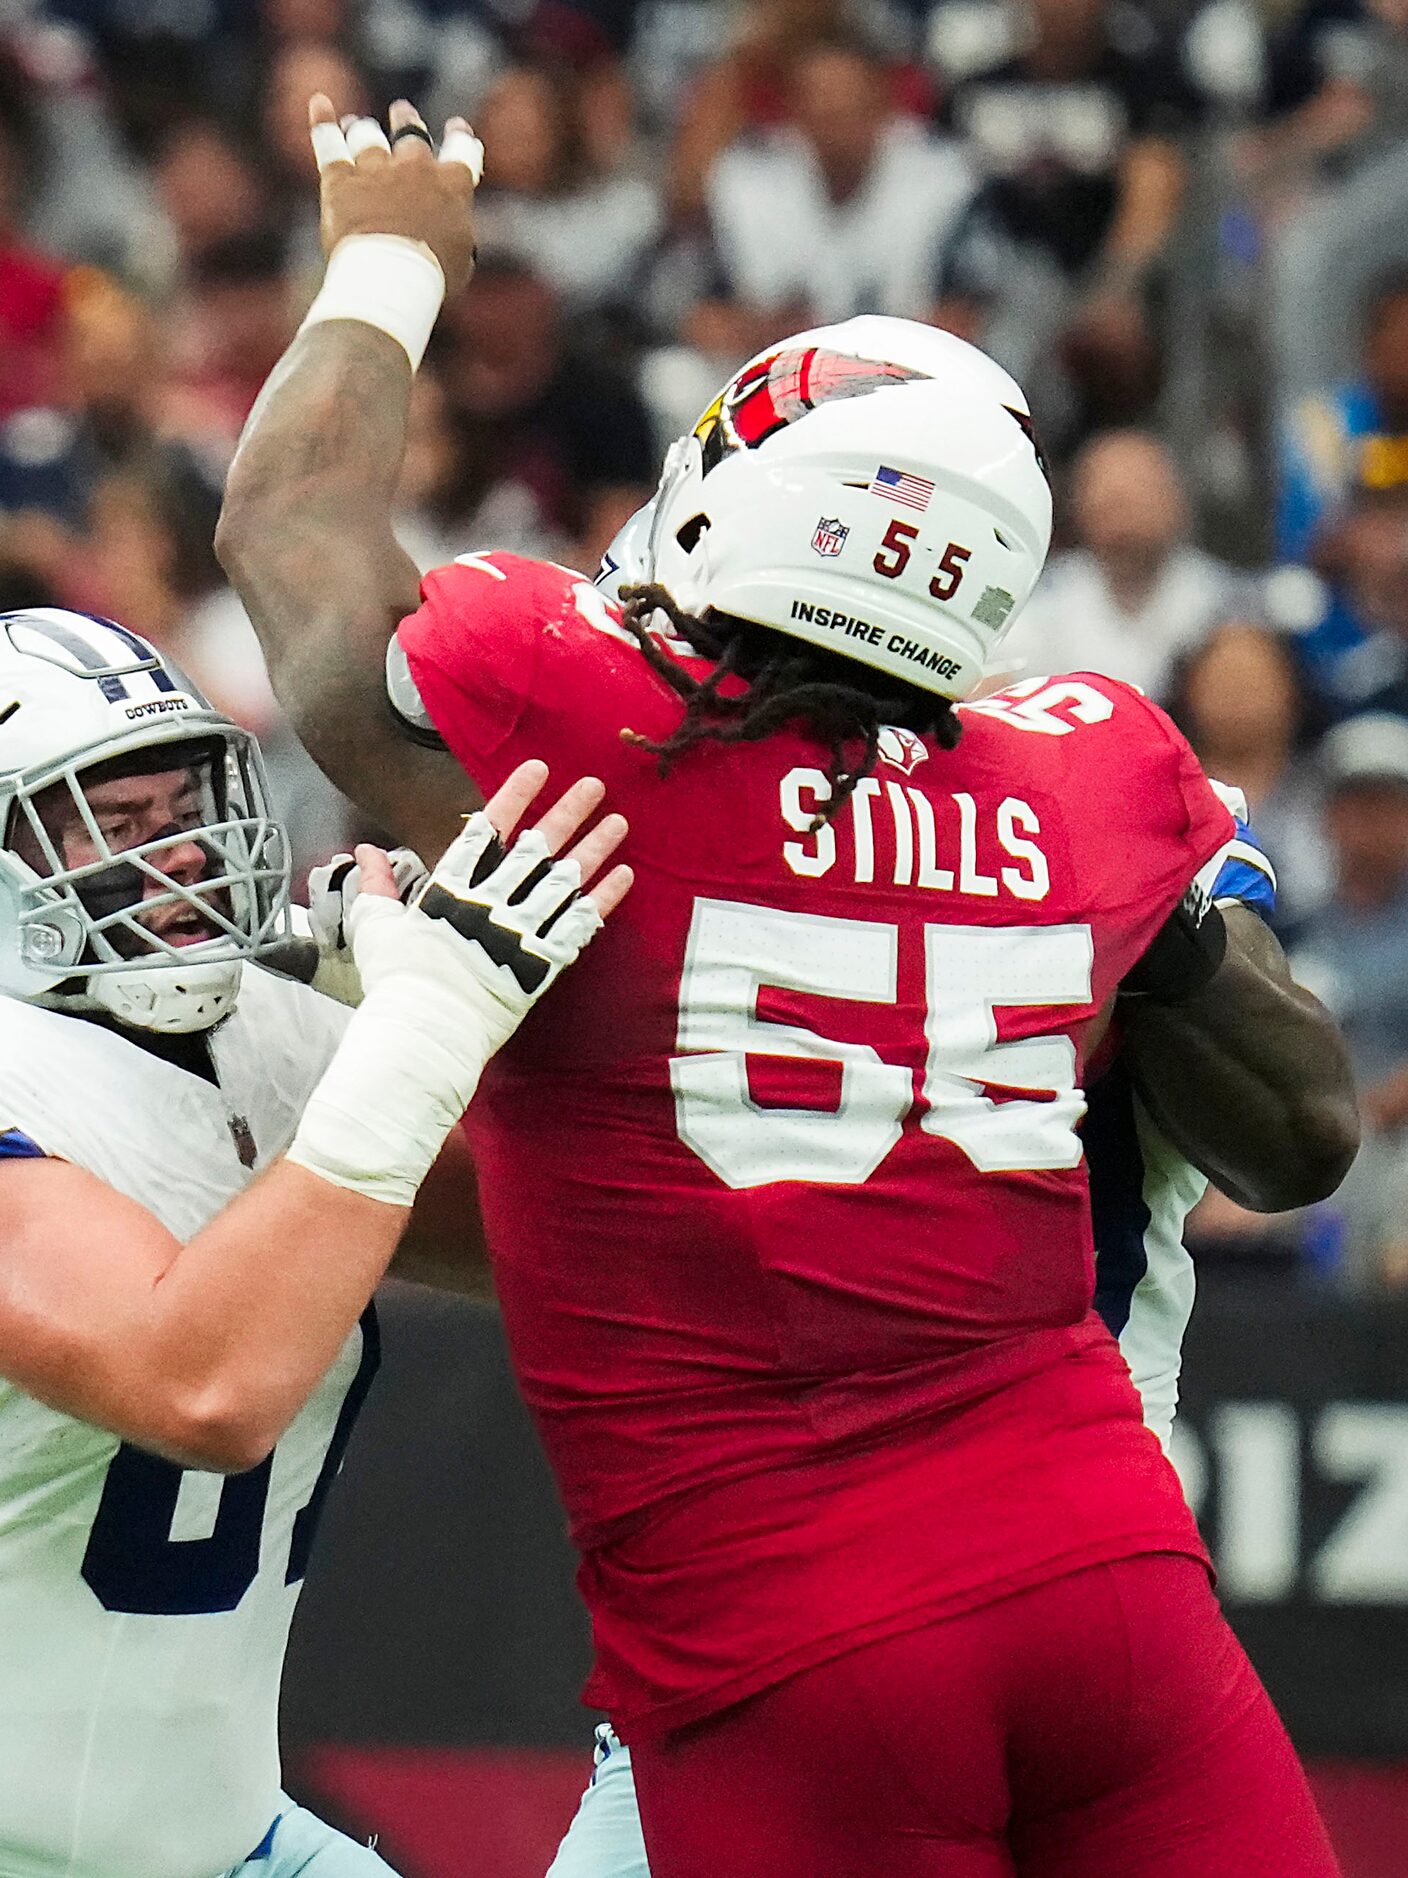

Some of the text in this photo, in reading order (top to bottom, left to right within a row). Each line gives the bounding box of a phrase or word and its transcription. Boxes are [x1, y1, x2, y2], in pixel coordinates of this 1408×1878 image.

[790, 600, 962, 681] INSPIRE CHANGE
[124, 698, 189, 720] COWBOYS
[779, 767, 1051, 902] STILLS
[668, 896, 1095, 1190] 55
